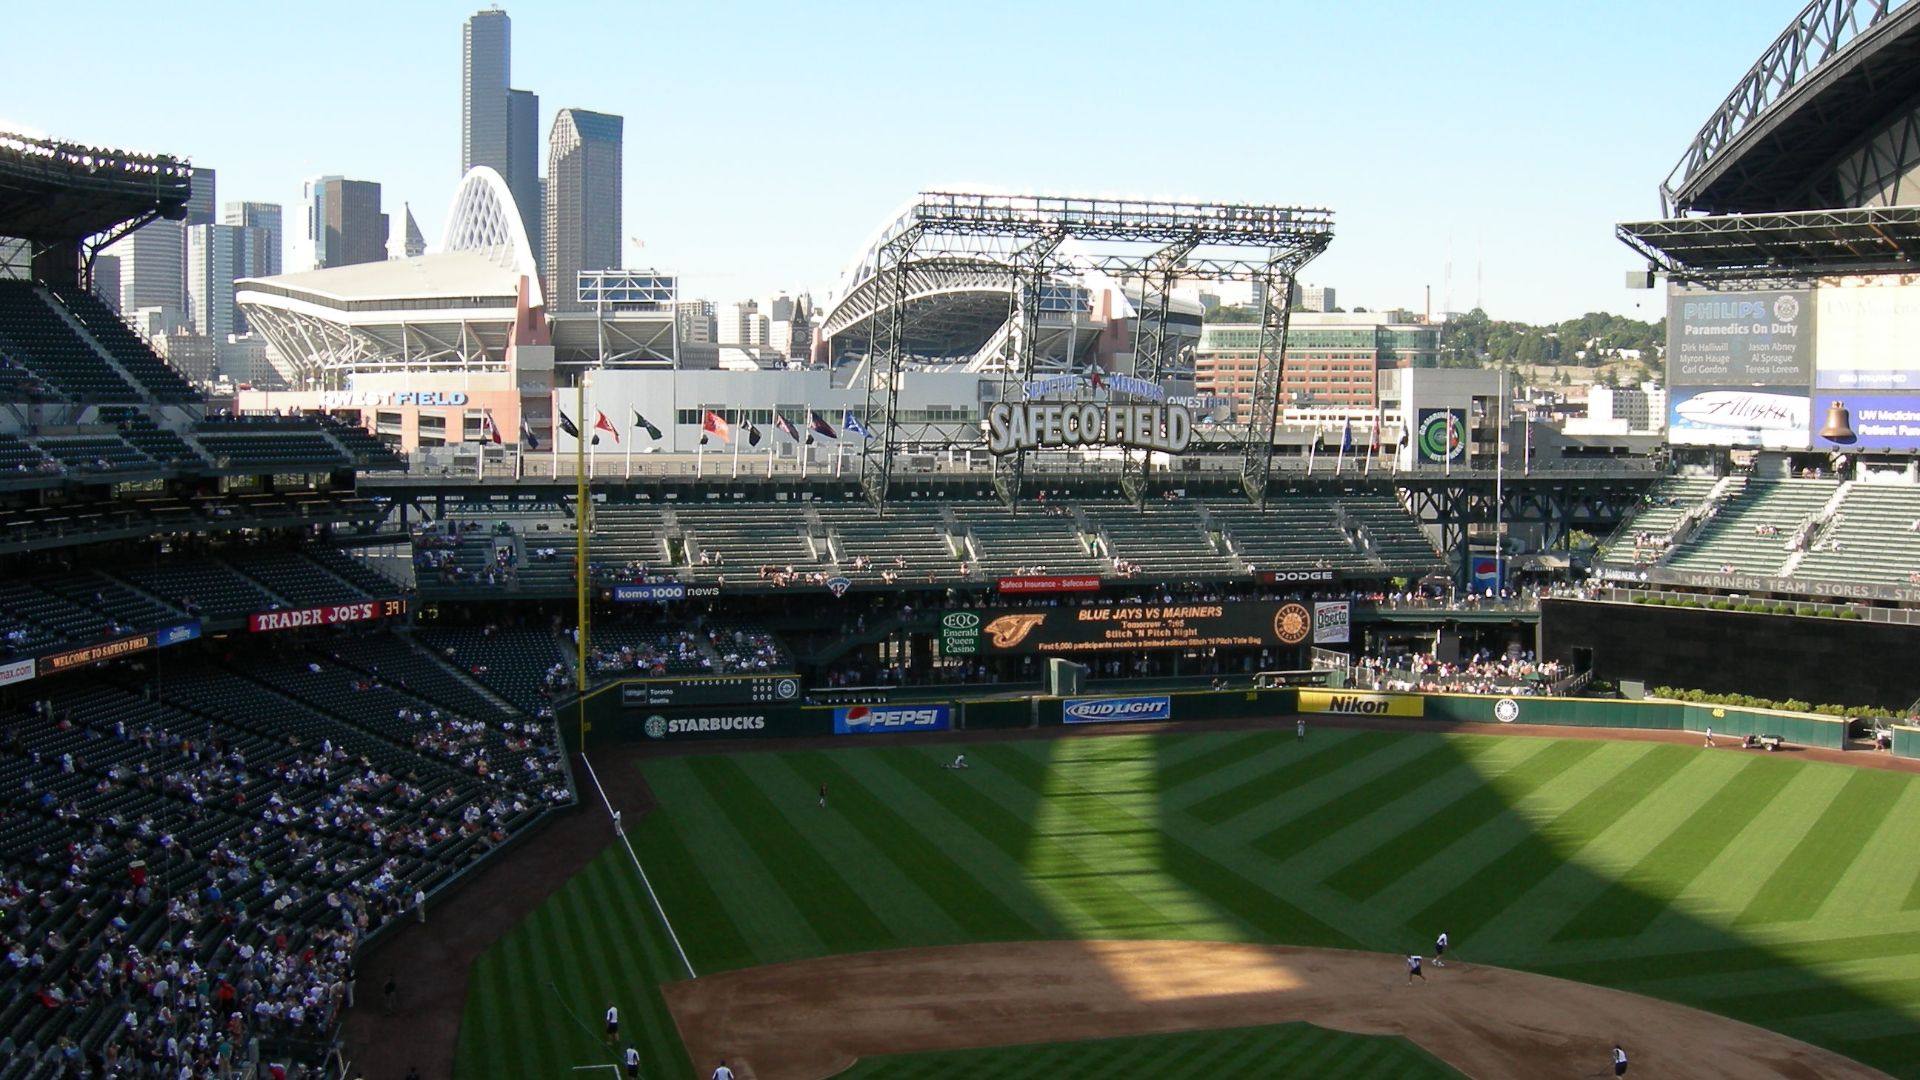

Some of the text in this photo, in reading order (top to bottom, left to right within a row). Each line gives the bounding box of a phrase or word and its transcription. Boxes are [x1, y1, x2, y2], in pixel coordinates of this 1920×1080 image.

[1684, 301, 1766, 320] PHILIPS
[1685, 323, 1798, 337] Paramedics On Duty
[1681, 343, 1696, 352] Dirk
[1749, 343, 1797, 353] Jason Abney
[1680, 354, 1730, 364] Myron Hauge
[1751, 354, 1792, 364] Al Sprague
[1682, 365, 1727, 374] Carl Gordon
[1745, 365, 1799, 374] Teresa Loreen
[393, 391, 468, 406] FIELD
[1859, 410, 1878, 421] UW
[988, 402, 1192, 455] SAFECO FIELD
[1859, 424, 1897, 436] Patient
[1275, 571, 1333, 581] DODGE
[1605, 568, 1637, 580] MARINERS
[832, 584, 846, 595] 42
[1000, 580, 1023, 589] Safeco
[1024, 580, 1056, 588] Insurance
[1062, 579, 1099, 588] Safeco.com
[1691, 574, 1760, 589] MARINERS
[1768, 579, 1806, 592] TEAM
[1815, 583, 1869, 596] STORES
[618, 587, 720, 599] komo 1000 news
[385, 599, 407, 616] 391
[1079, 606, 1223, 621] BLUE JAYS VS MARINERS
[257, 603, 373, 631] TRADER JOE'S
[947, 614, 976, 628] EQC
[1318, 610, 1347, 627] Oberto
[1121, 621, 1161, 629] Tomorrow
[943, 628, 979, 637] Emerald
[1105, 629, 1132, 639] Stitch
[1147, 629, 1171, 638] Pitch
[1173, 628, 1198, 637] Night
[946, 637, 975, 645] Queen
[1074, 642, 1112, 651] participants
[1113, 641, 1137, 649] receive
[53, 636, 149, 668] WELCOME TO SAFECO FIELD
[946, 645, 975, 654] Casino
[1078, 702, 1166, 716] BUD LIGHT
[1329, 696, 1390, 713] Nikon
[668, 716, 765, 732] STARBUCKS
[870, 710, 938, 726] PEPSI
